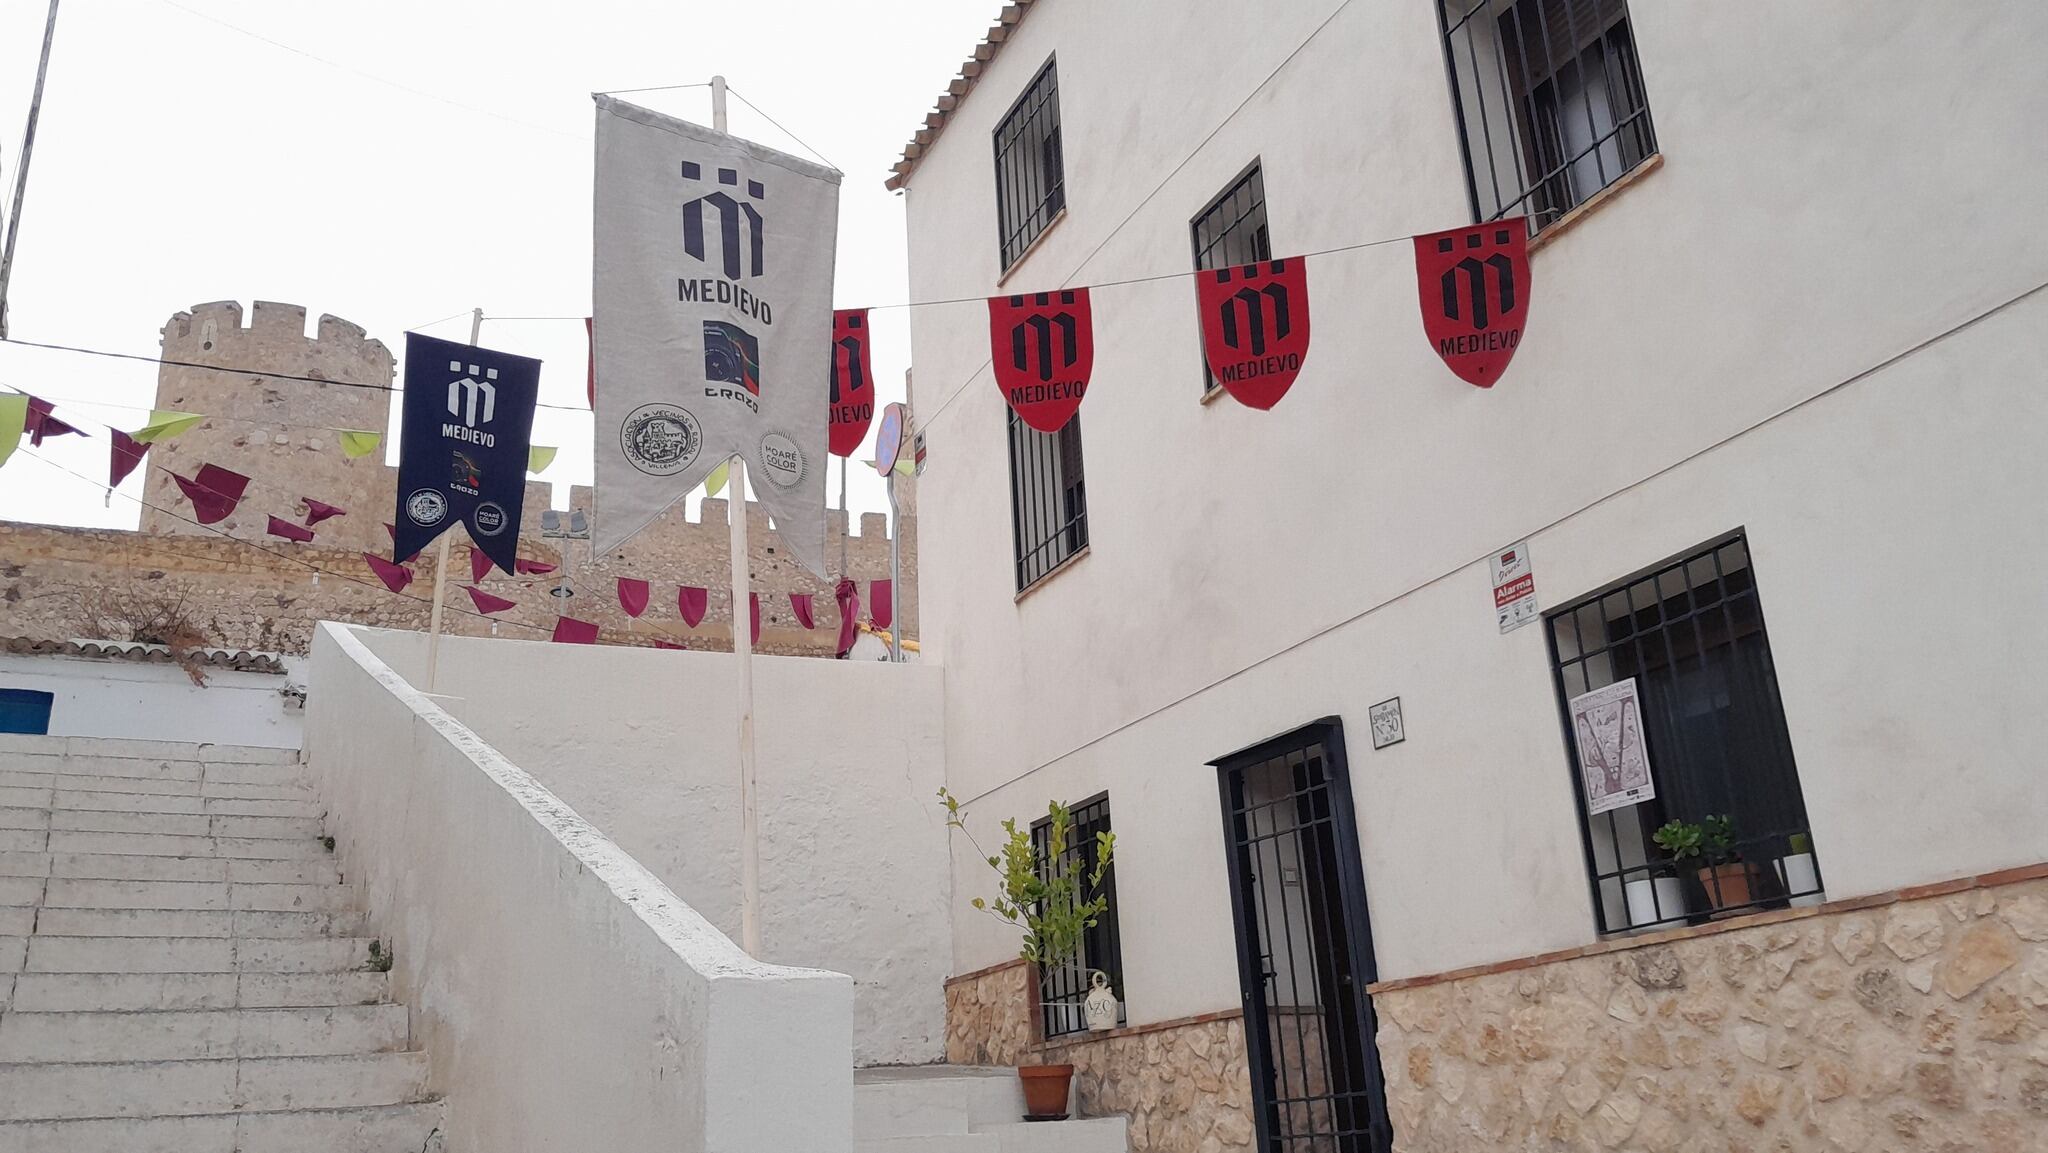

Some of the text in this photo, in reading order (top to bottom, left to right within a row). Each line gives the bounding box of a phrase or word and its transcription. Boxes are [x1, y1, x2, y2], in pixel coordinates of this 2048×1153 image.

[678, 278, 772, 325] MEDIEVO
[1440, 328, 1519, 357] MEDIEVO
[1221, 353, 1300, 383] MEDIEVO
[1010, 380, 1085, 405] MEDIEVO
[828, 402, 871, 425] DIEVO
[442, 423, 495, 448] MEDIEVO
[766, 454, 797, 470] COLOR
[1496, 578, 1532, 600] Alarma
